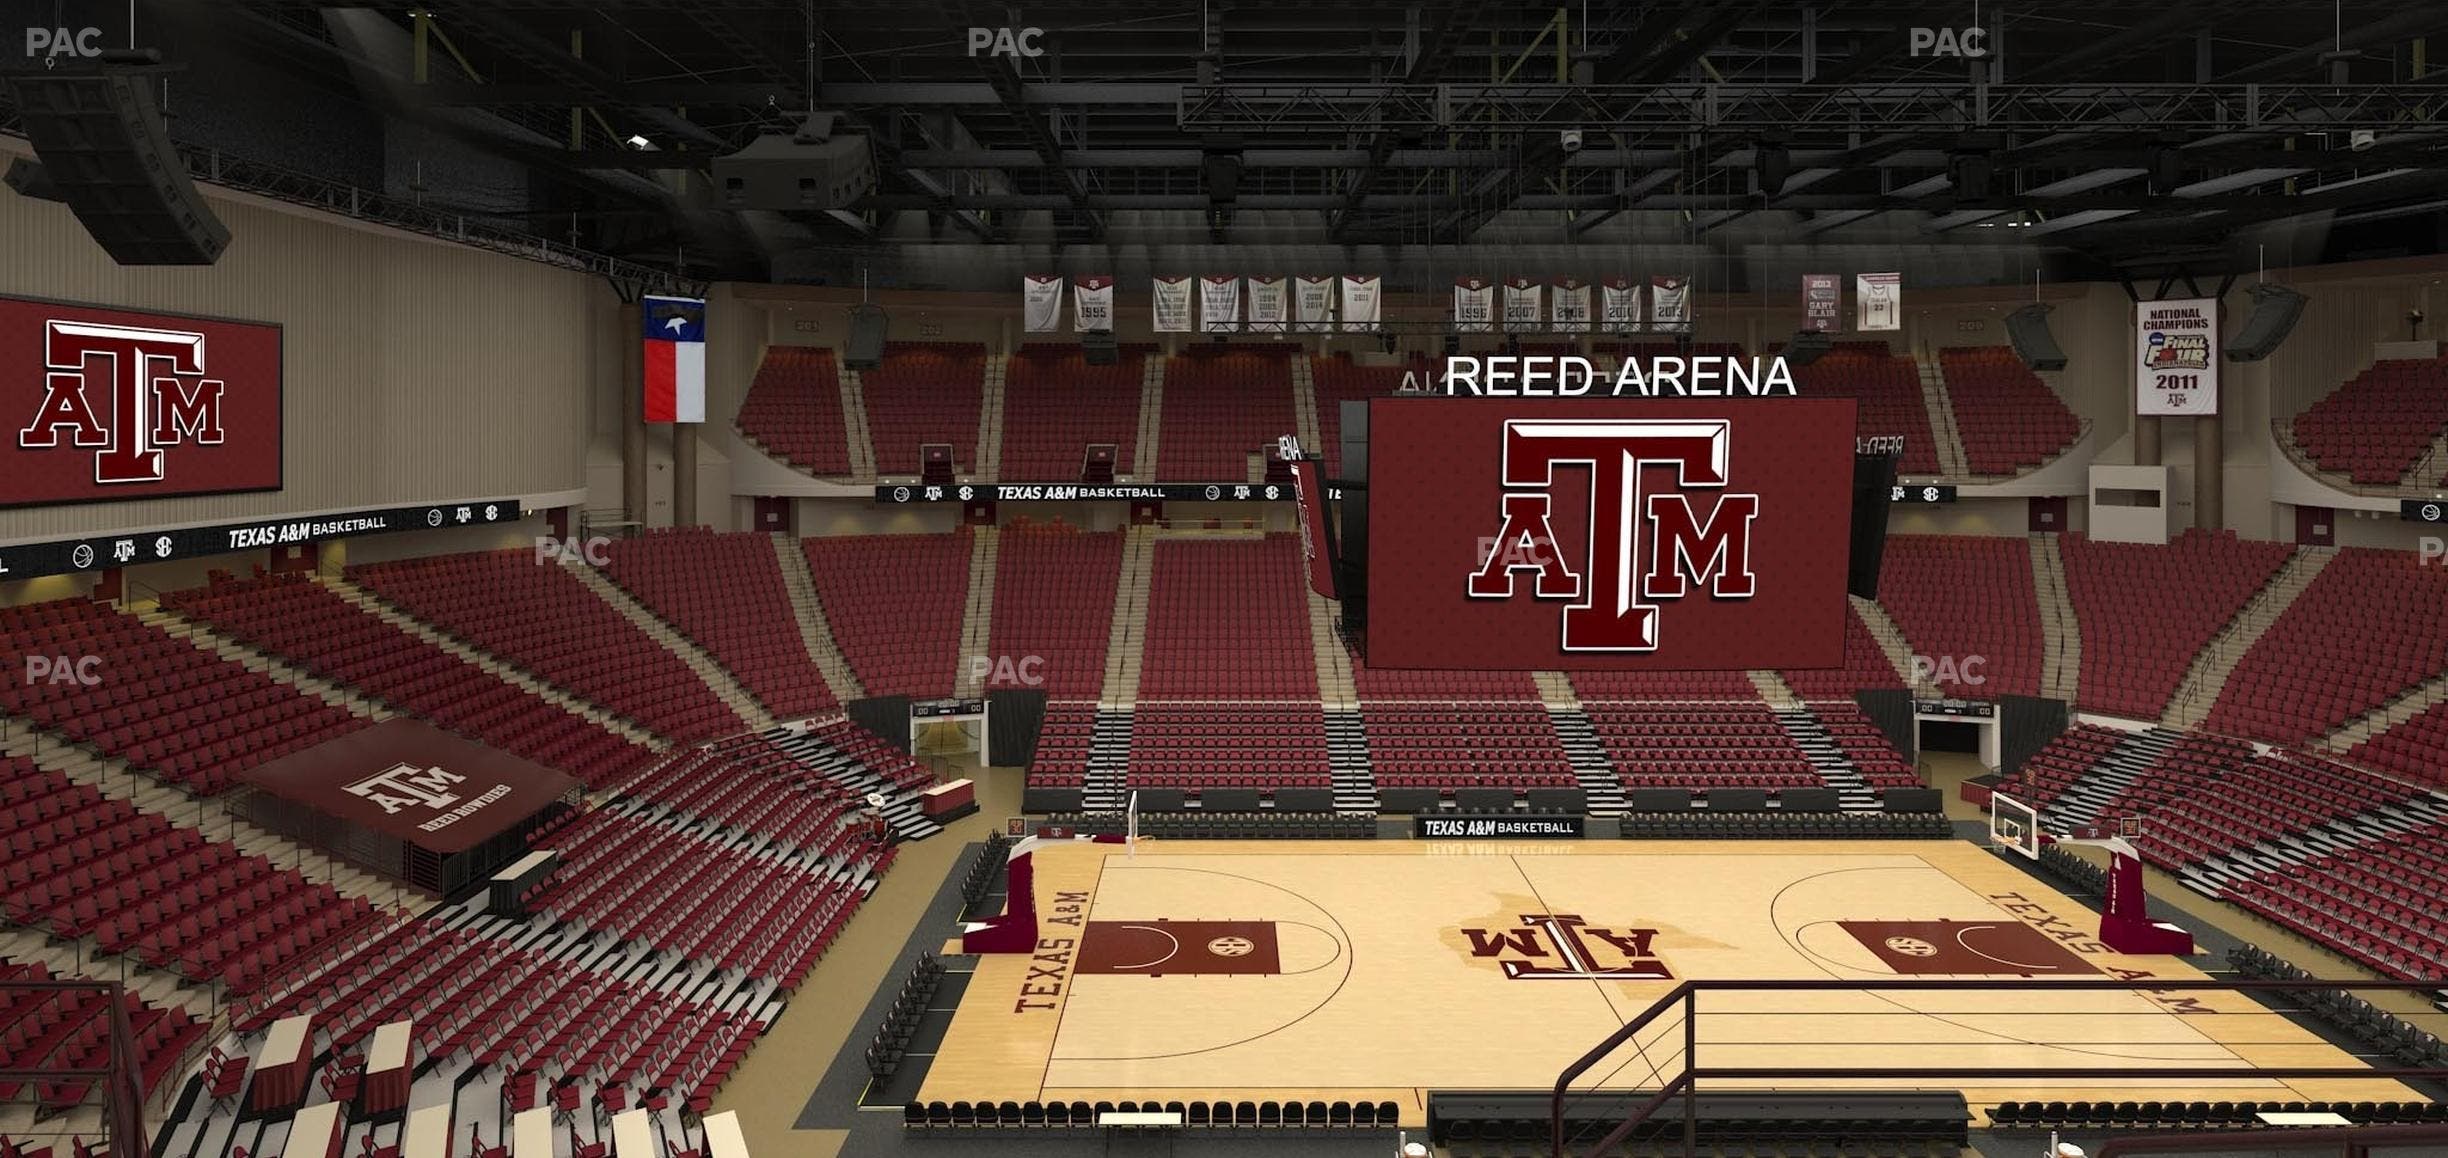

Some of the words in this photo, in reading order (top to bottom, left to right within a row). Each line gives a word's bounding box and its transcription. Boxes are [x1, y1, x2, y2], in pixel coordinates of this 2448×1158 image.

[1081, 306, 1107, 318] 1995
[1508, 306, 1536, 318] 2007
[1557, 306, 1585, 318] 208
[2150, 308, 2201, 320] NATIONAL
[2143, 318, 2209, 330] CHAMPIONS
[2162, 336, 2206, 349] FINAL
[1447, 356, 1594, 396] REED
[1612, 356, 1798, 396] ARENA
[2156, 375, 2198, 389] 2011
[998, 486, 1042, 499] TEXAS
[1044, 486, 1077, 499] A&M
[1079, 488, 1165, 497] BASKETBALL
[229, 526, 276, 548] TEXAS
[278, 523, 310, 543] A&M
[312, 516, 387, 536] BASKETBALL
[417, 813, 461, 832] REED
[451, 784, 512, 817] ROWDIES
[1425, 820, 1465, 836] TEXAS
[1467, 820, 1496, 836] A&M
[1497, 822, 1574, 833] BASKETBALL
[1989, 891, 2115, 954] TEXAS
[1014, 938, 1075, 1013] TEXAS
[1047, 892, 1090, 927] A&M
